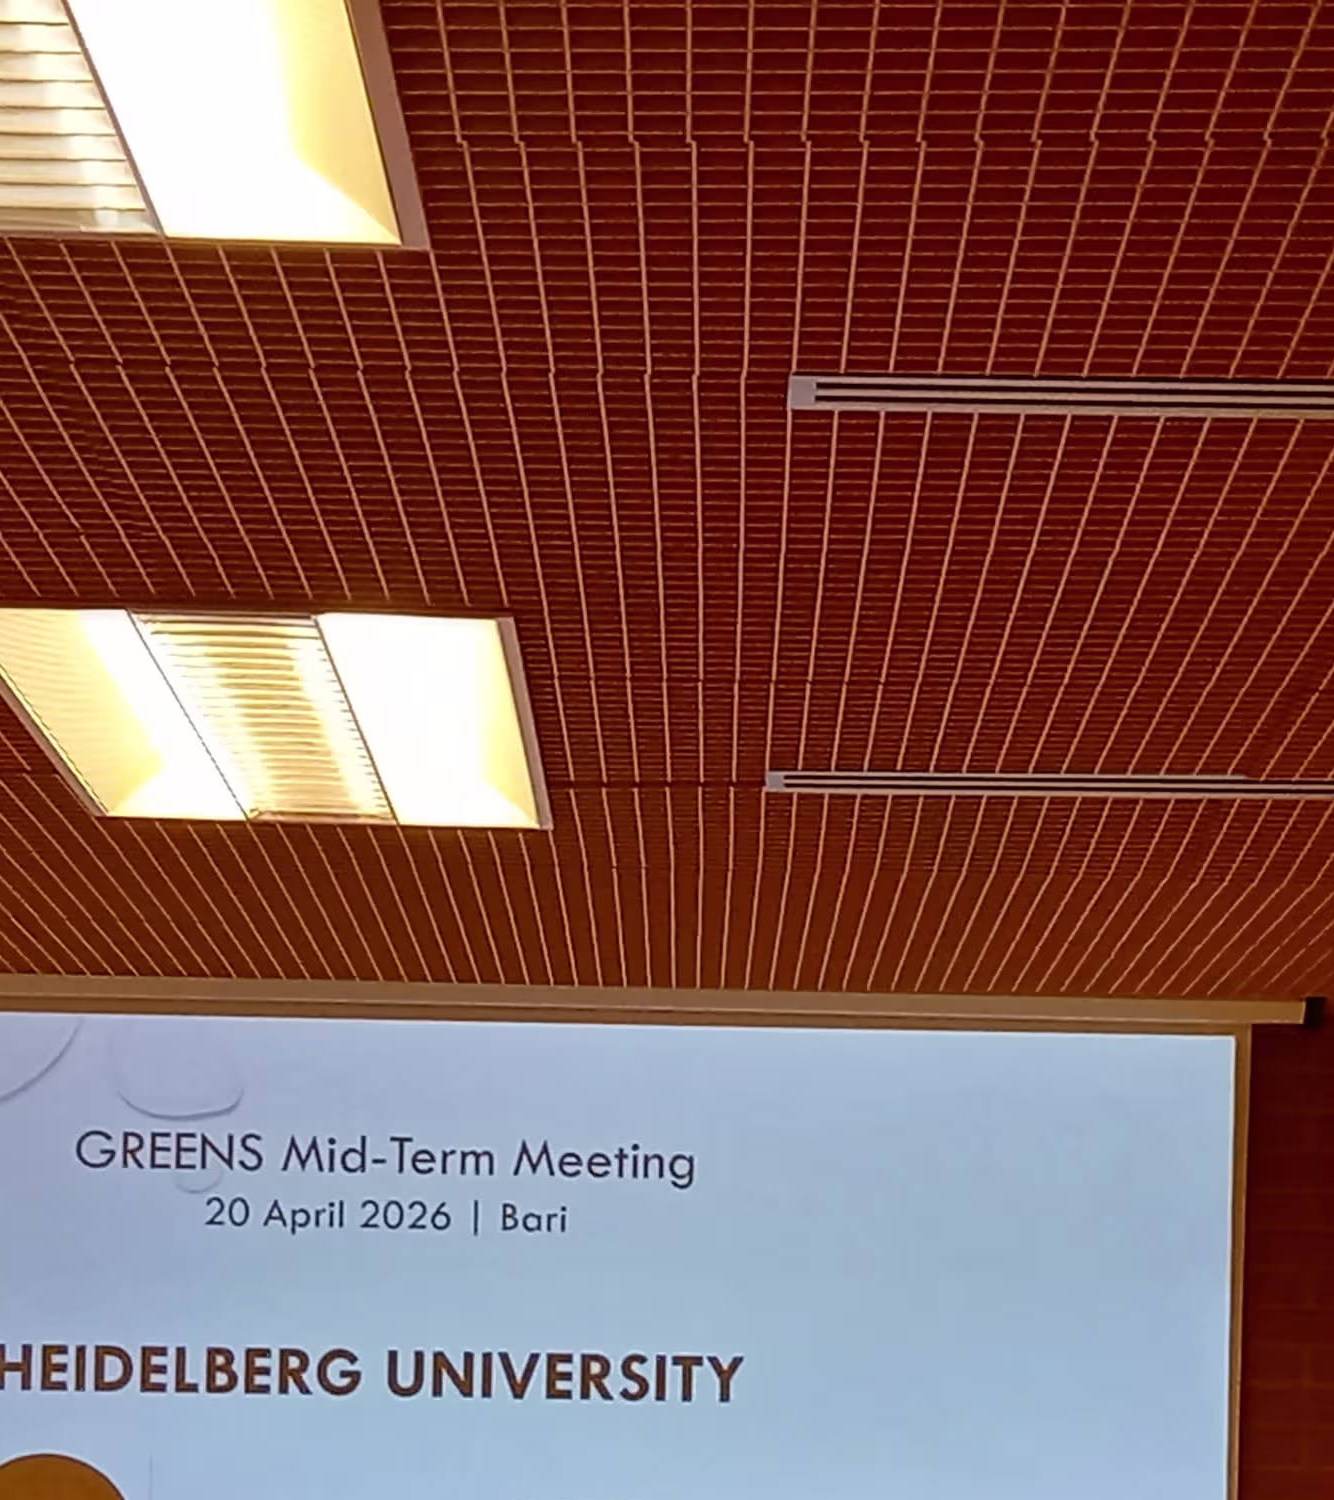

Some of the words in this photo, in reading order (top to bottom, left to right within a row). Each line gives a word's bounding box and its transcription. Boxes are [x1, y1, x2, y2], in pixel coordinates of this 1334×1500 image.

[75, 1130, 264, 1172] GREENS
[281, 1135, 495, 1177] Mid-Term
[512, 1139, 695, 1190] Meeting
[204, 1196, 250, 1227] 20
[262, 1198, 345, 1236] April
[360, 1199, 452, 1231] 2026
[501, 1202, 567, 1233] Bari
[387, 1349, 744, 1403] UNIVERSITY
